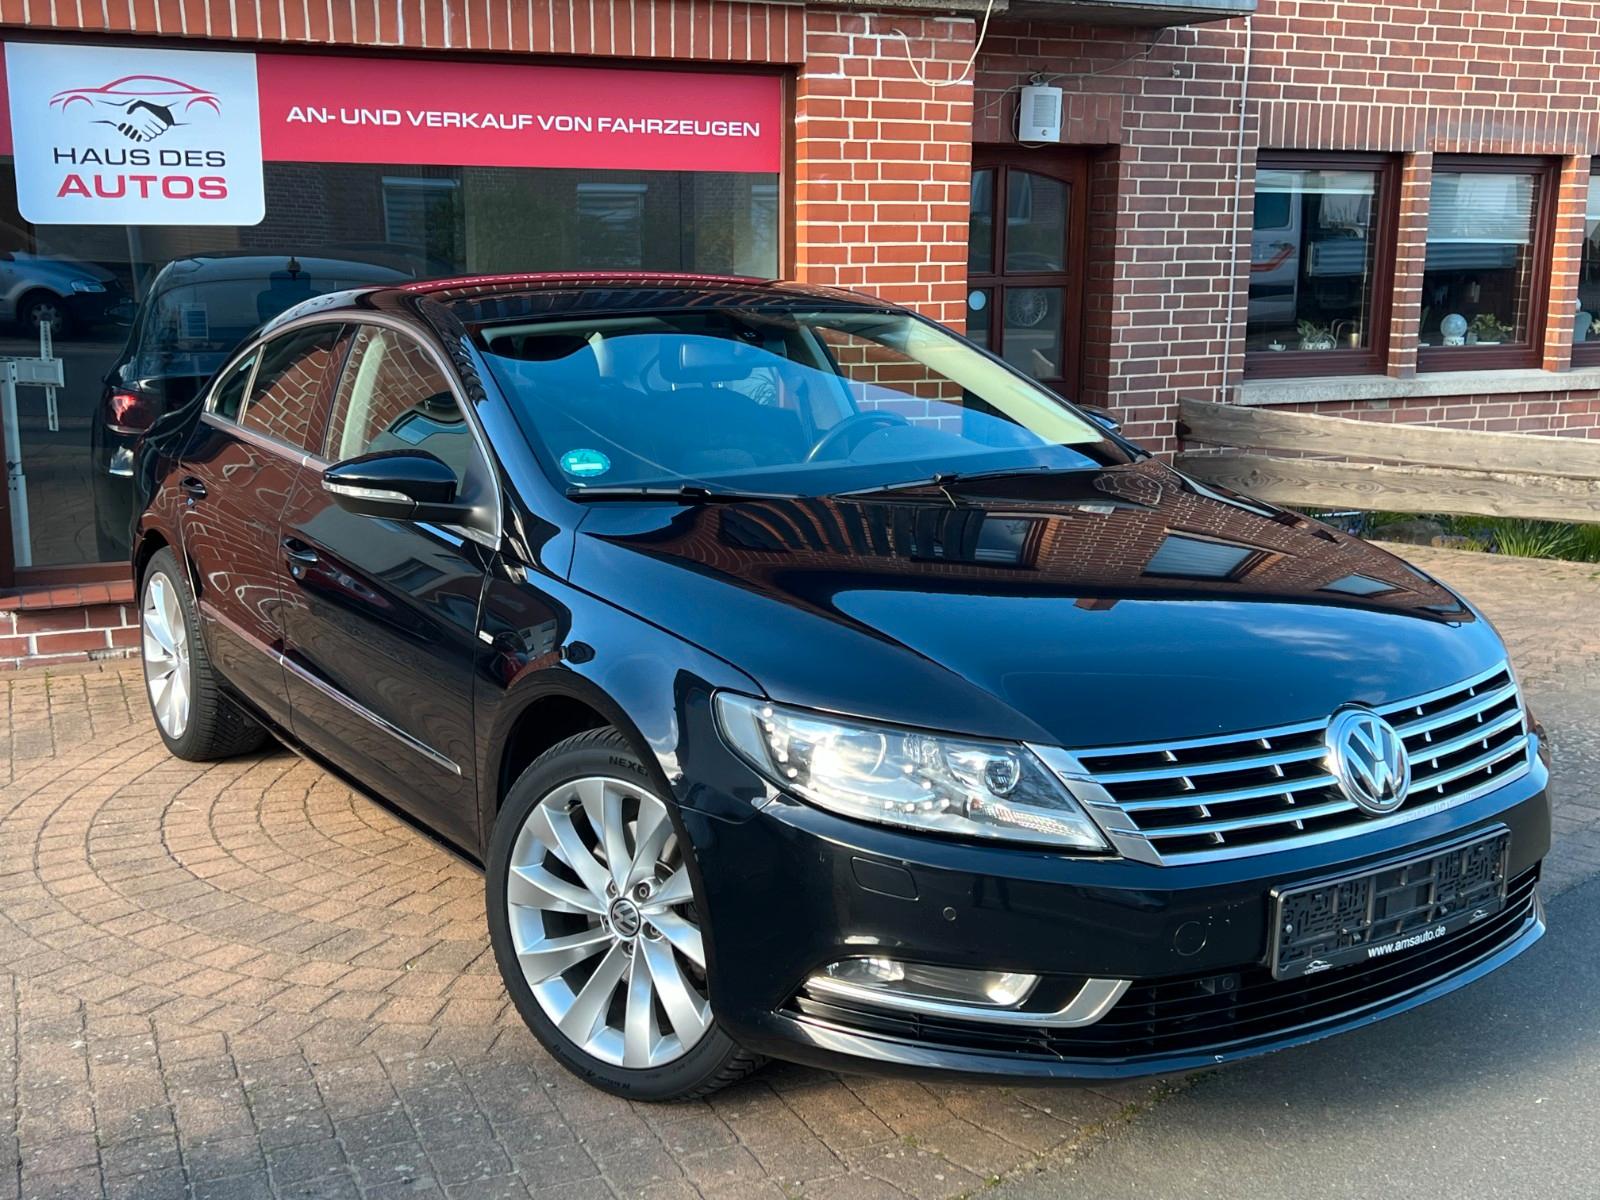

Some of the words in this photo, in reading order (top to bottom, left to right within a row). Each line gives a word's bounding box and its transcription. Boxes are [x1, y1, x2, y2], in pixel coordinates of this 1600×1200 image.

[286, 106, 336, 123] AN-
[340, 108, 401, 126] UND
[406, 110, 533, 129] VERKAUF
[537, 115, 592, 132] VON
[597, 117, 760, 137] FAHRZEUGEN
[53, 147, 150, 166] HAUS
[160, 150, 226, 167] DES
[56, 174, 228, 200] AUTOS
[609, 755, 649, 777] NEXE
[1367, 925, 1447, 958] www.amsauto.de
